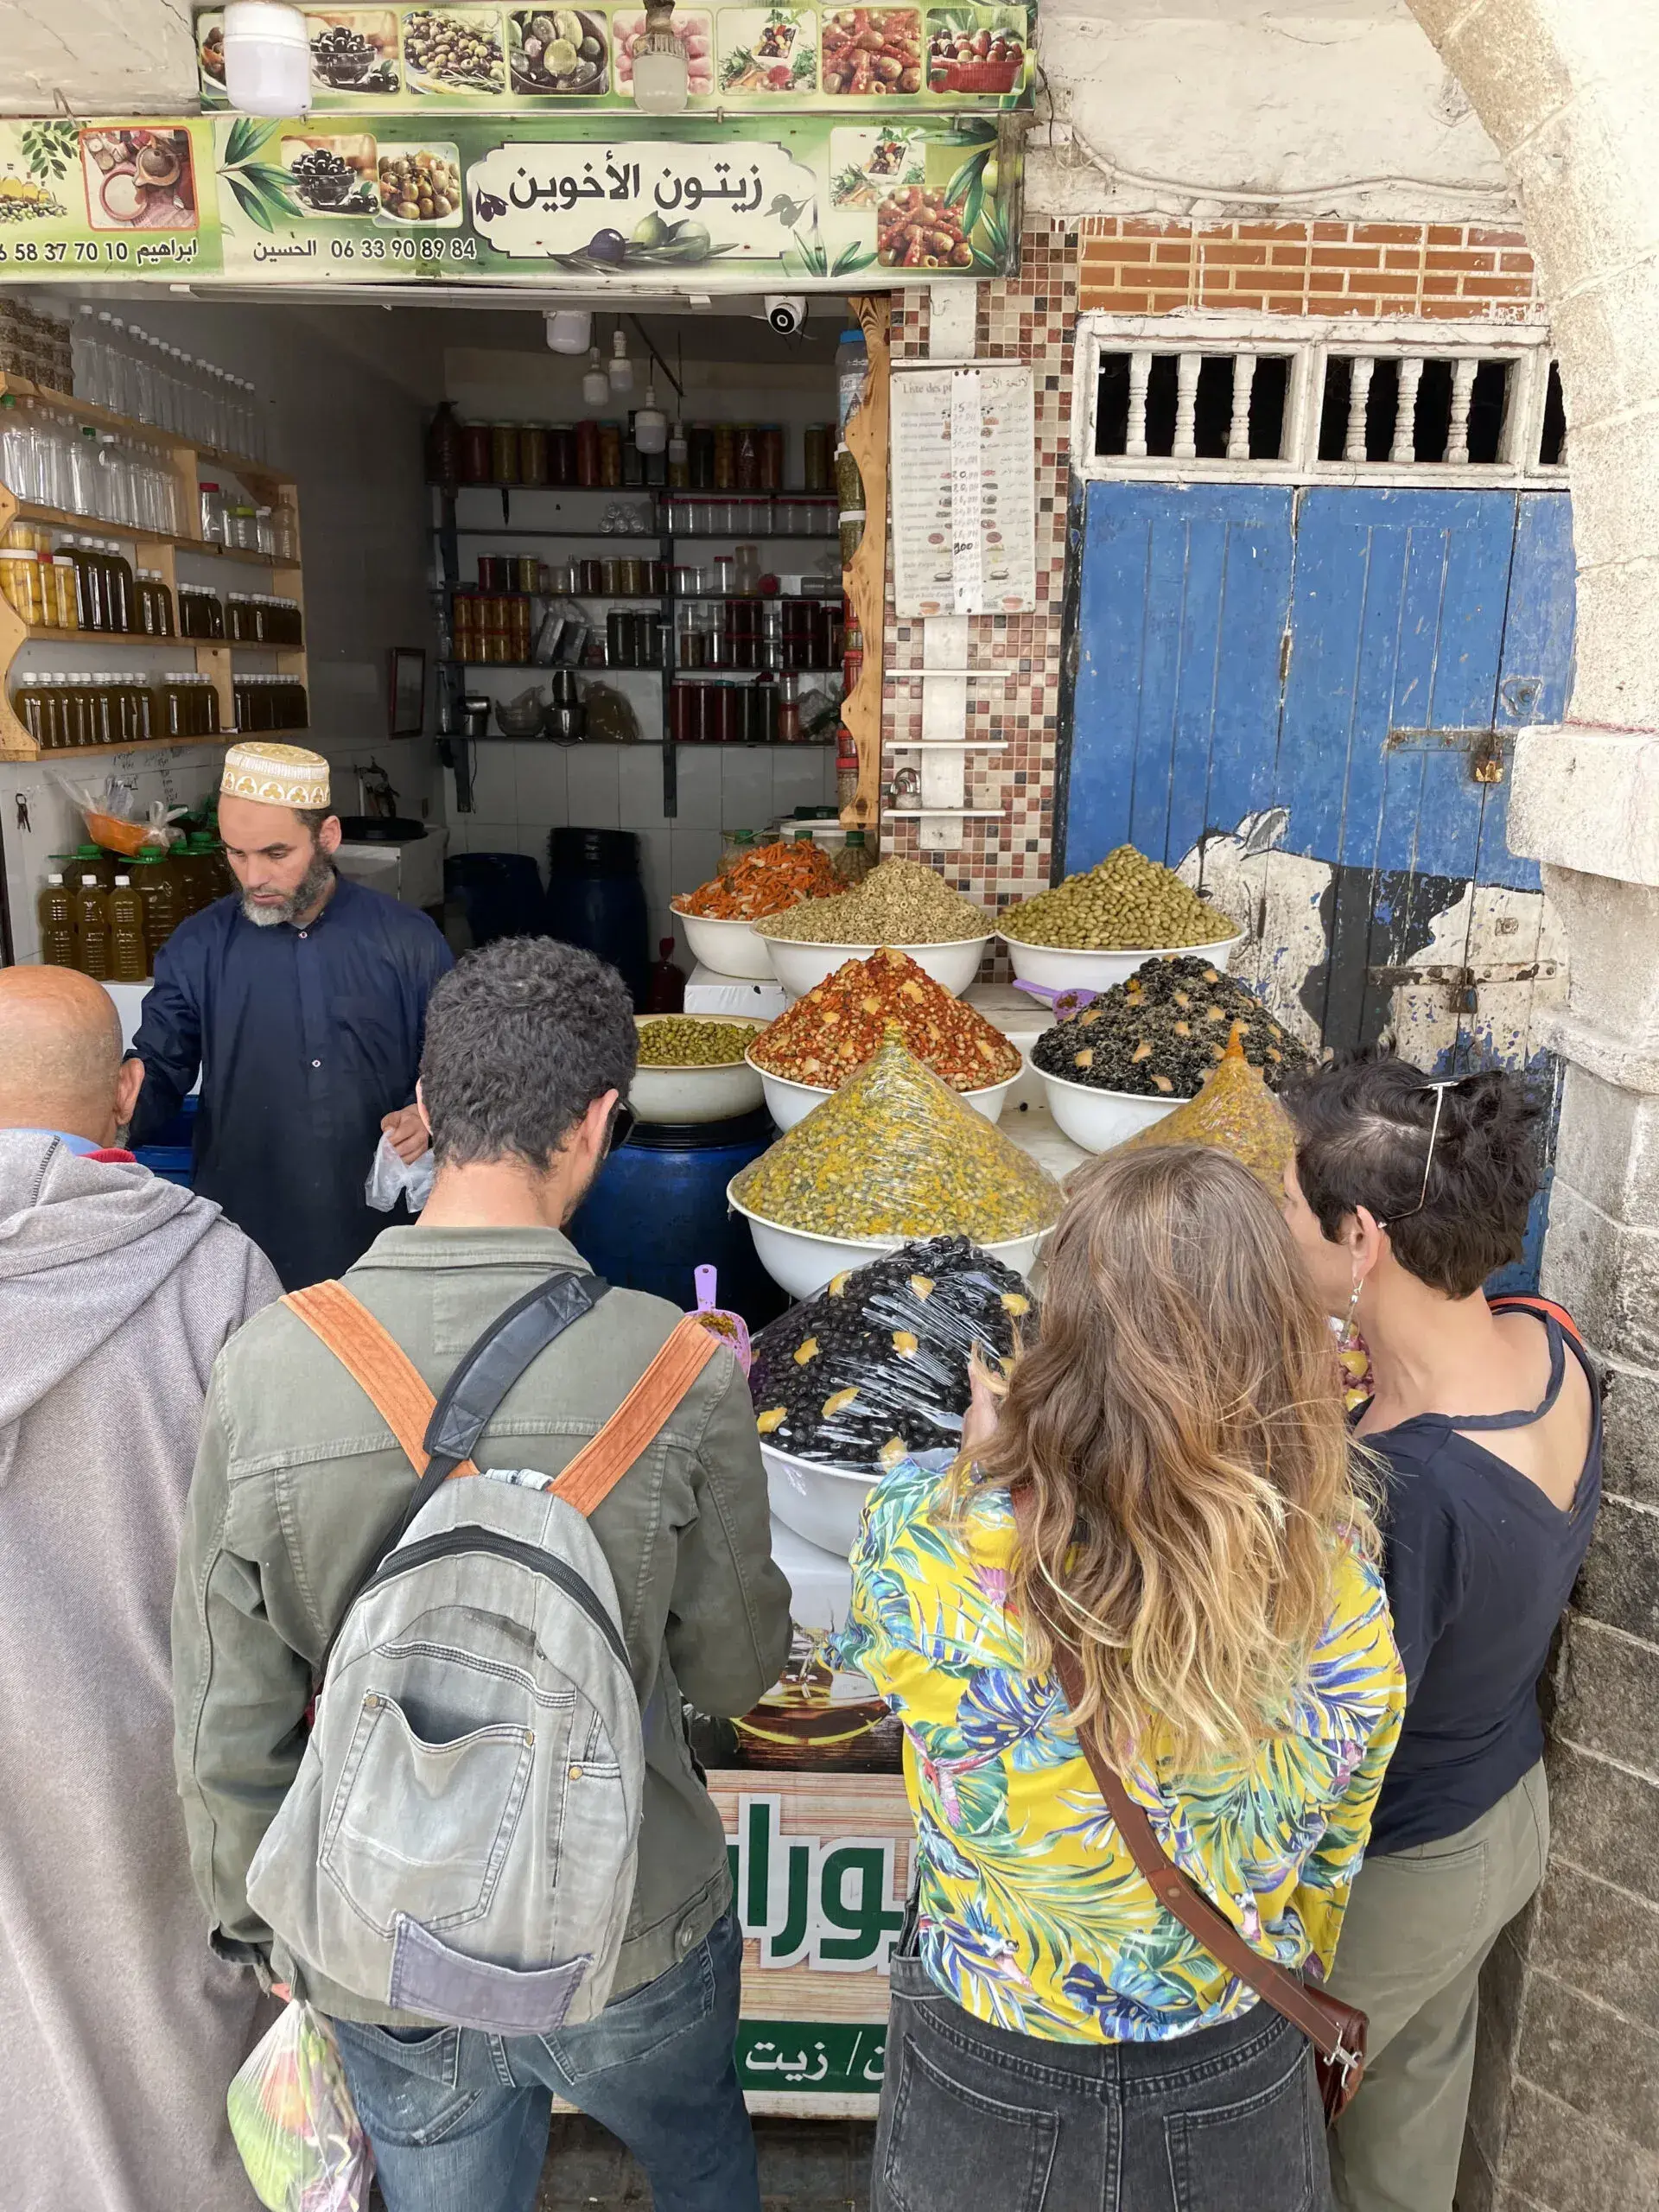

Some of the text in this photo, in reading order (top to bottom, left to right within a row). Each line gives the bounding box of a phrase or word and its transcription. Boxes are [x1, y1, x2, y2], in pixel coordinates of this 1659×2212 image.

[508, 149, 761, 211] زيتون الأخوين
[15, 243, 38, 261] 58
[44, 242, 67, 261] 37
[74, 242, 98, 261] 70
[104, 242, 128, 260] 10
[136, 238, 197, 264] ابراهيم
[253, 239, 475, 262] الحسين 06 33 90 89 84
[903, 382, 924, 394] Liste
[926, 382, 941, 394] des
[745, 2041, 827, 2081] زيت
